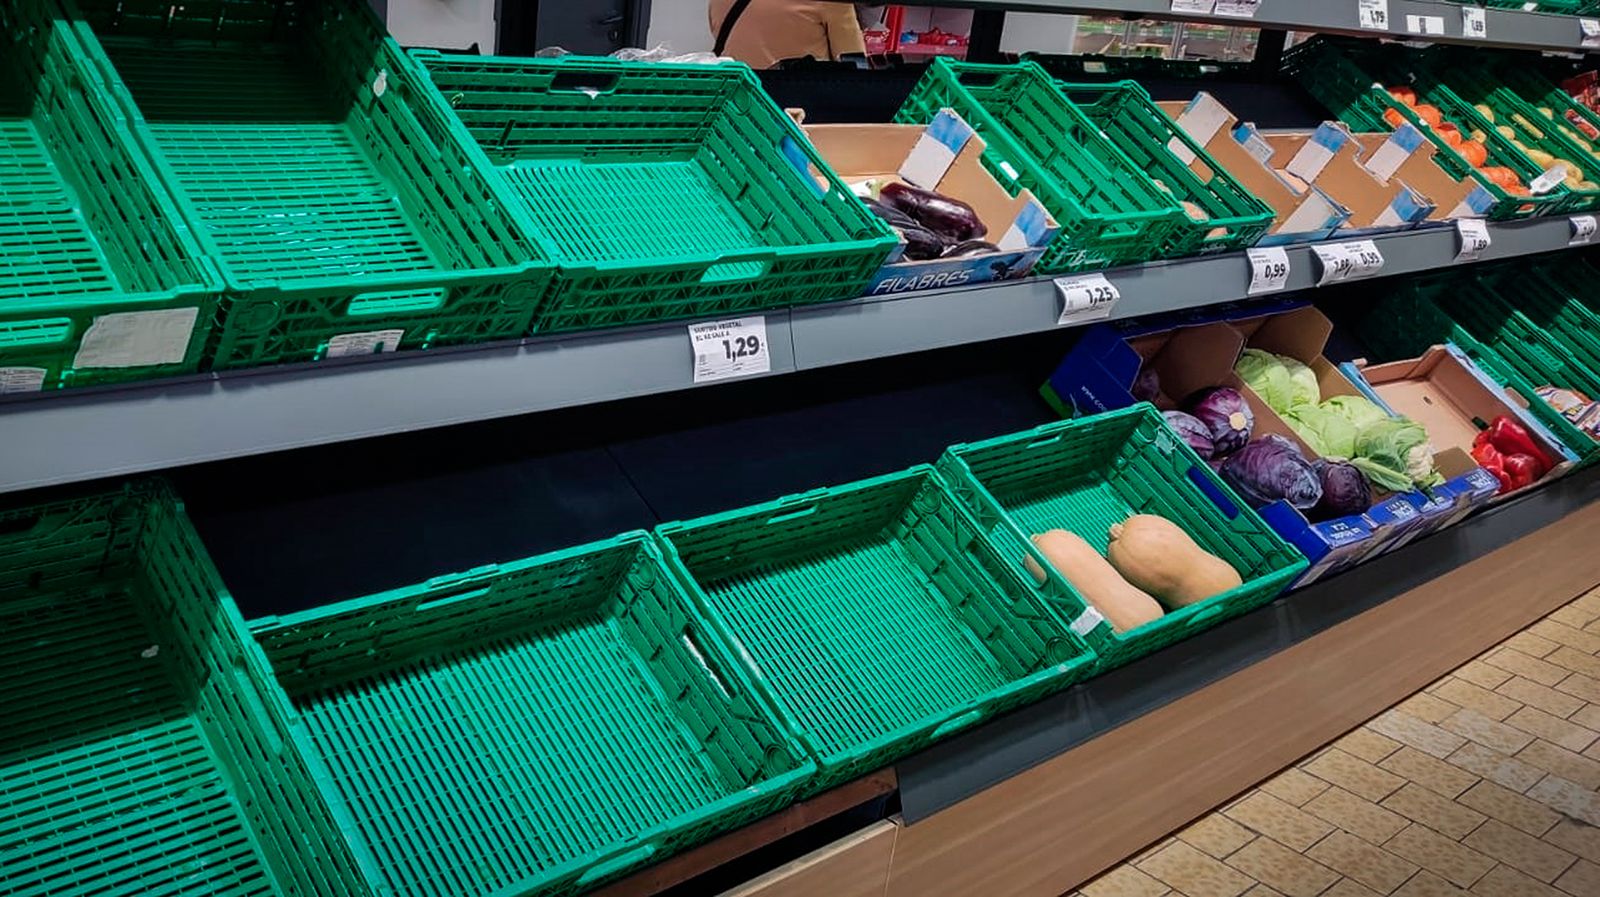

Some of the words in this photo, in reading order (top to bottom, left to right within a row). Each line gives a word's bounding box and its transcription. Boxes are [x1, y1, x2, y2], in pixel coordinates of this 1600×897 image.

[1359, 252, 1380, 267] 0,99
[1264, 263, 1286, 280] 0,99
[872, 268, 975, 295] FILABRES
[1085, 287, 1113, 306] 1,25
[722, 335, 759, 362] 1,29
